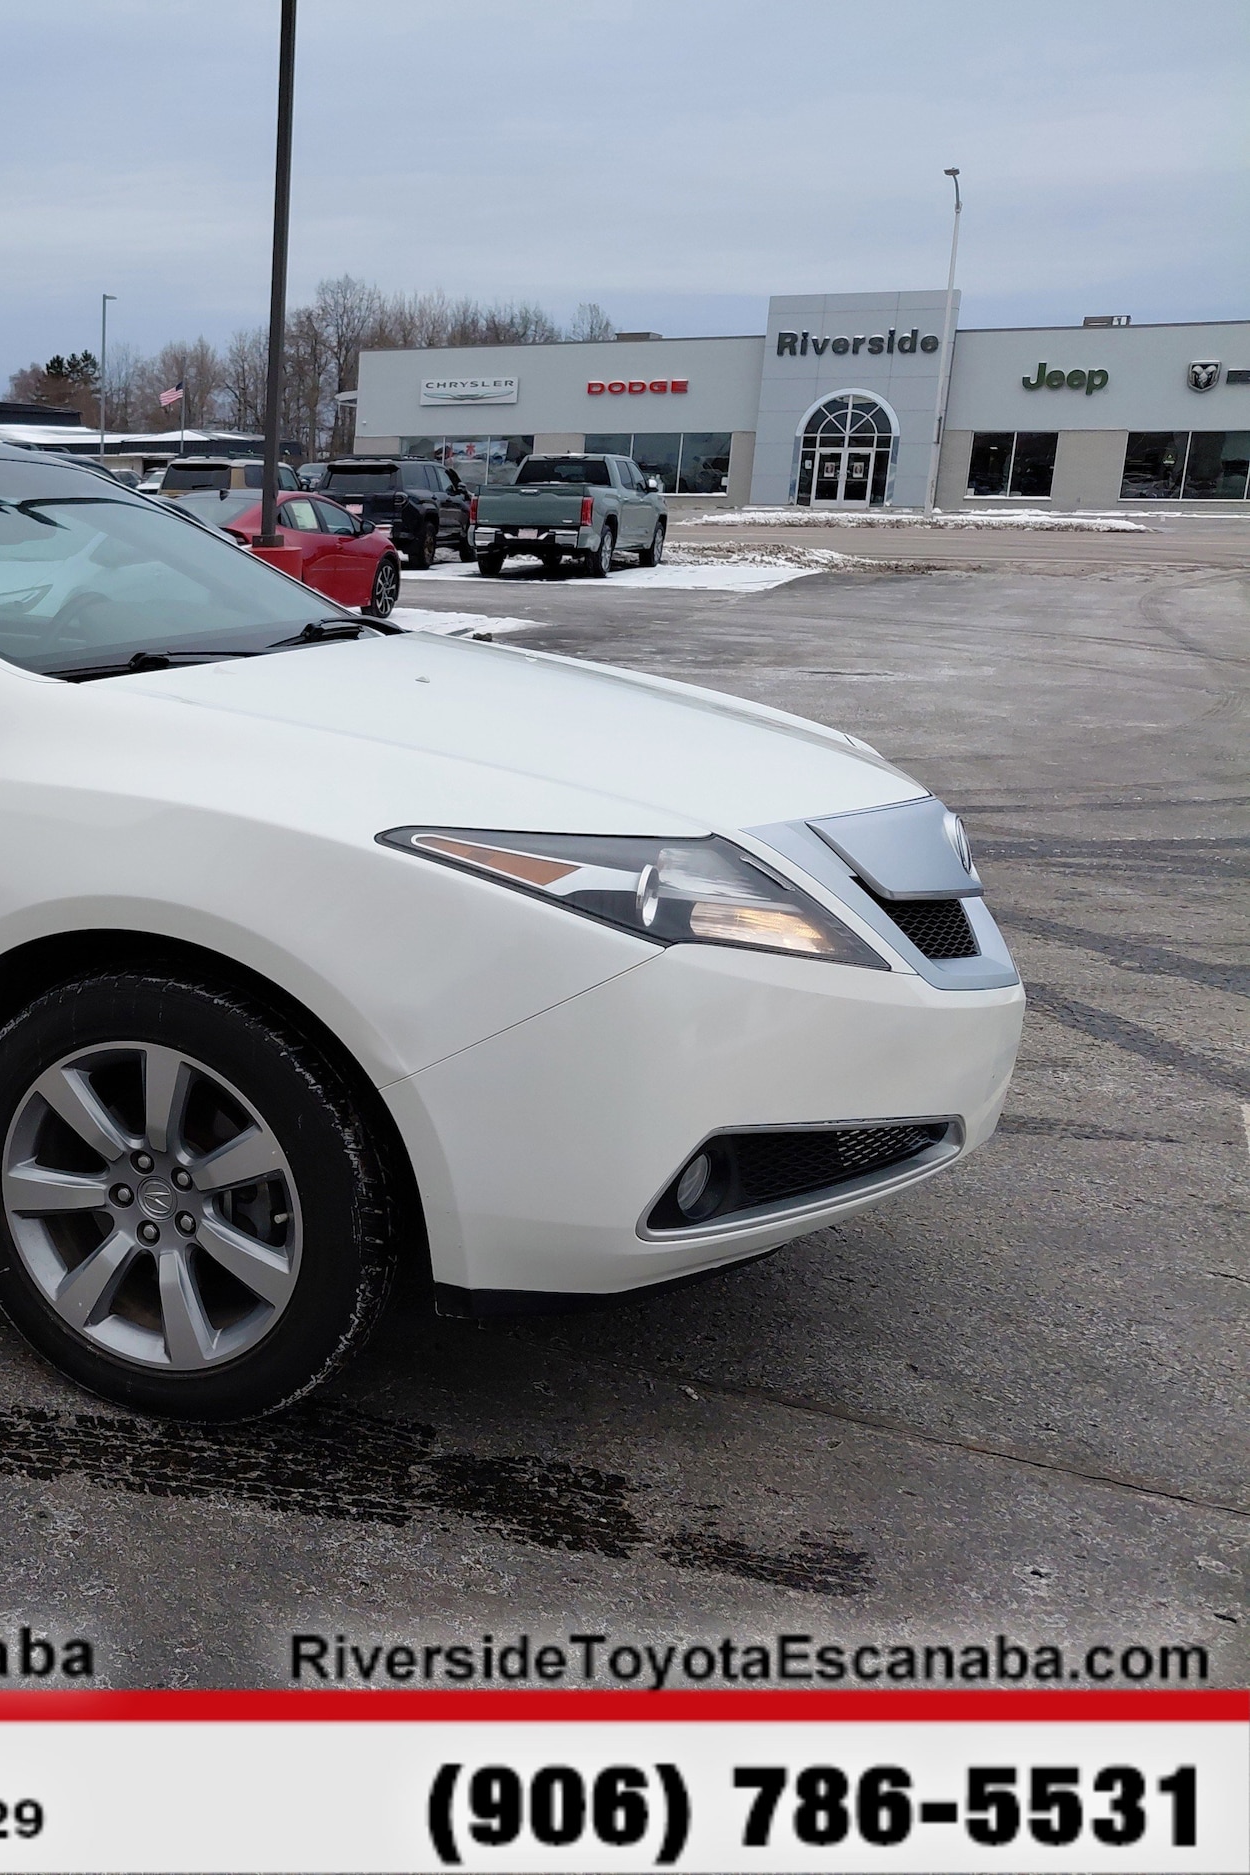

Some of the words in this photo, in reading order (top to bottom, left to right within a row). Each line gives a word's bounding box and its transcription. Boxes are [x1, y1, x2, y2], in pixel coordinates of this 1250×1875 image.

[776, 327, 939, 356] Riverside
[425, 380, 514, 389] CHRYSLER
[587, 379, 689, 395] DODGE
[1023, 362, 1109, 396] Jeep
